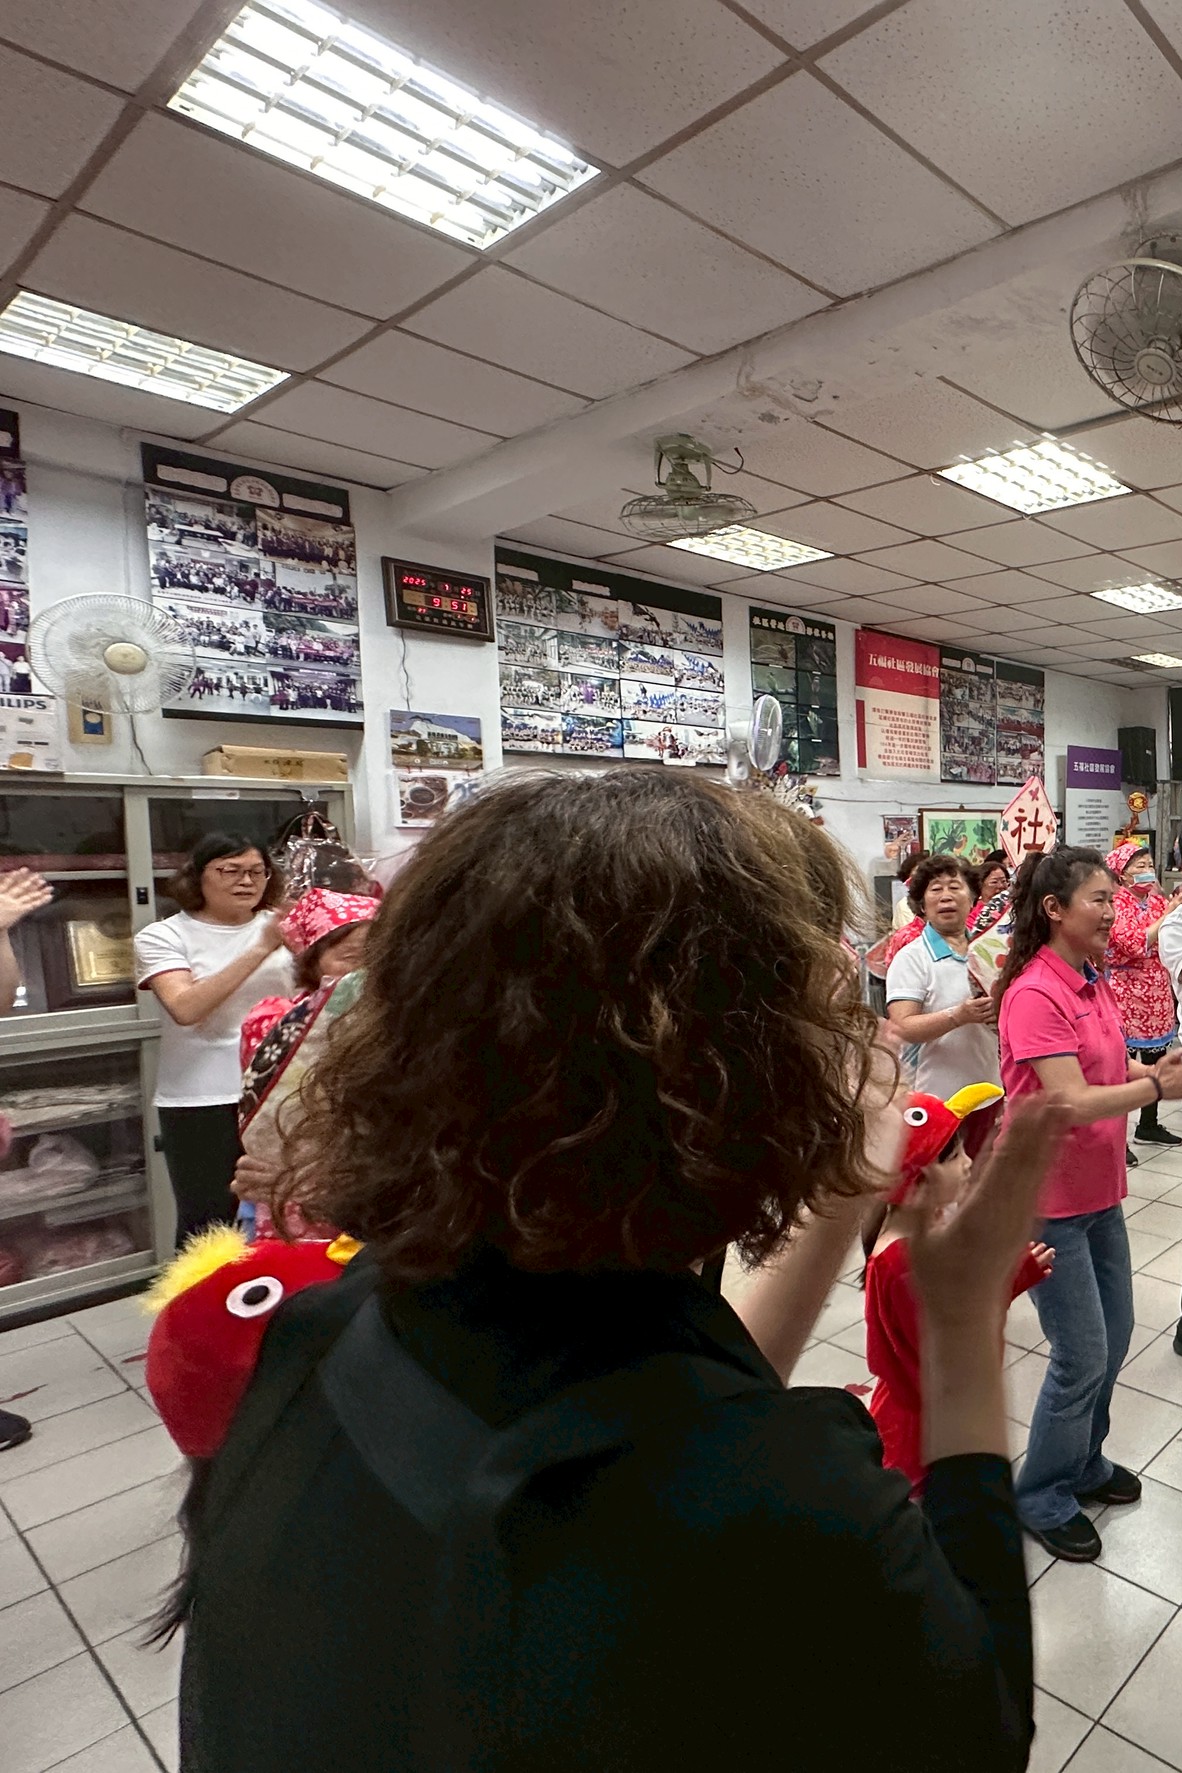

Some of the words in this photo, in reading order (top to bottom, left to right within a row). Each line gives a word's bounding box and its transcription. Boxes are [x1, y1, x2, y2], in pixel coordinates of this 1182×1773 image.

[402, 576, 427, 586] 2025
[460, 587, 472, 596] 25
[1010, 807, 1046, 855] 社
